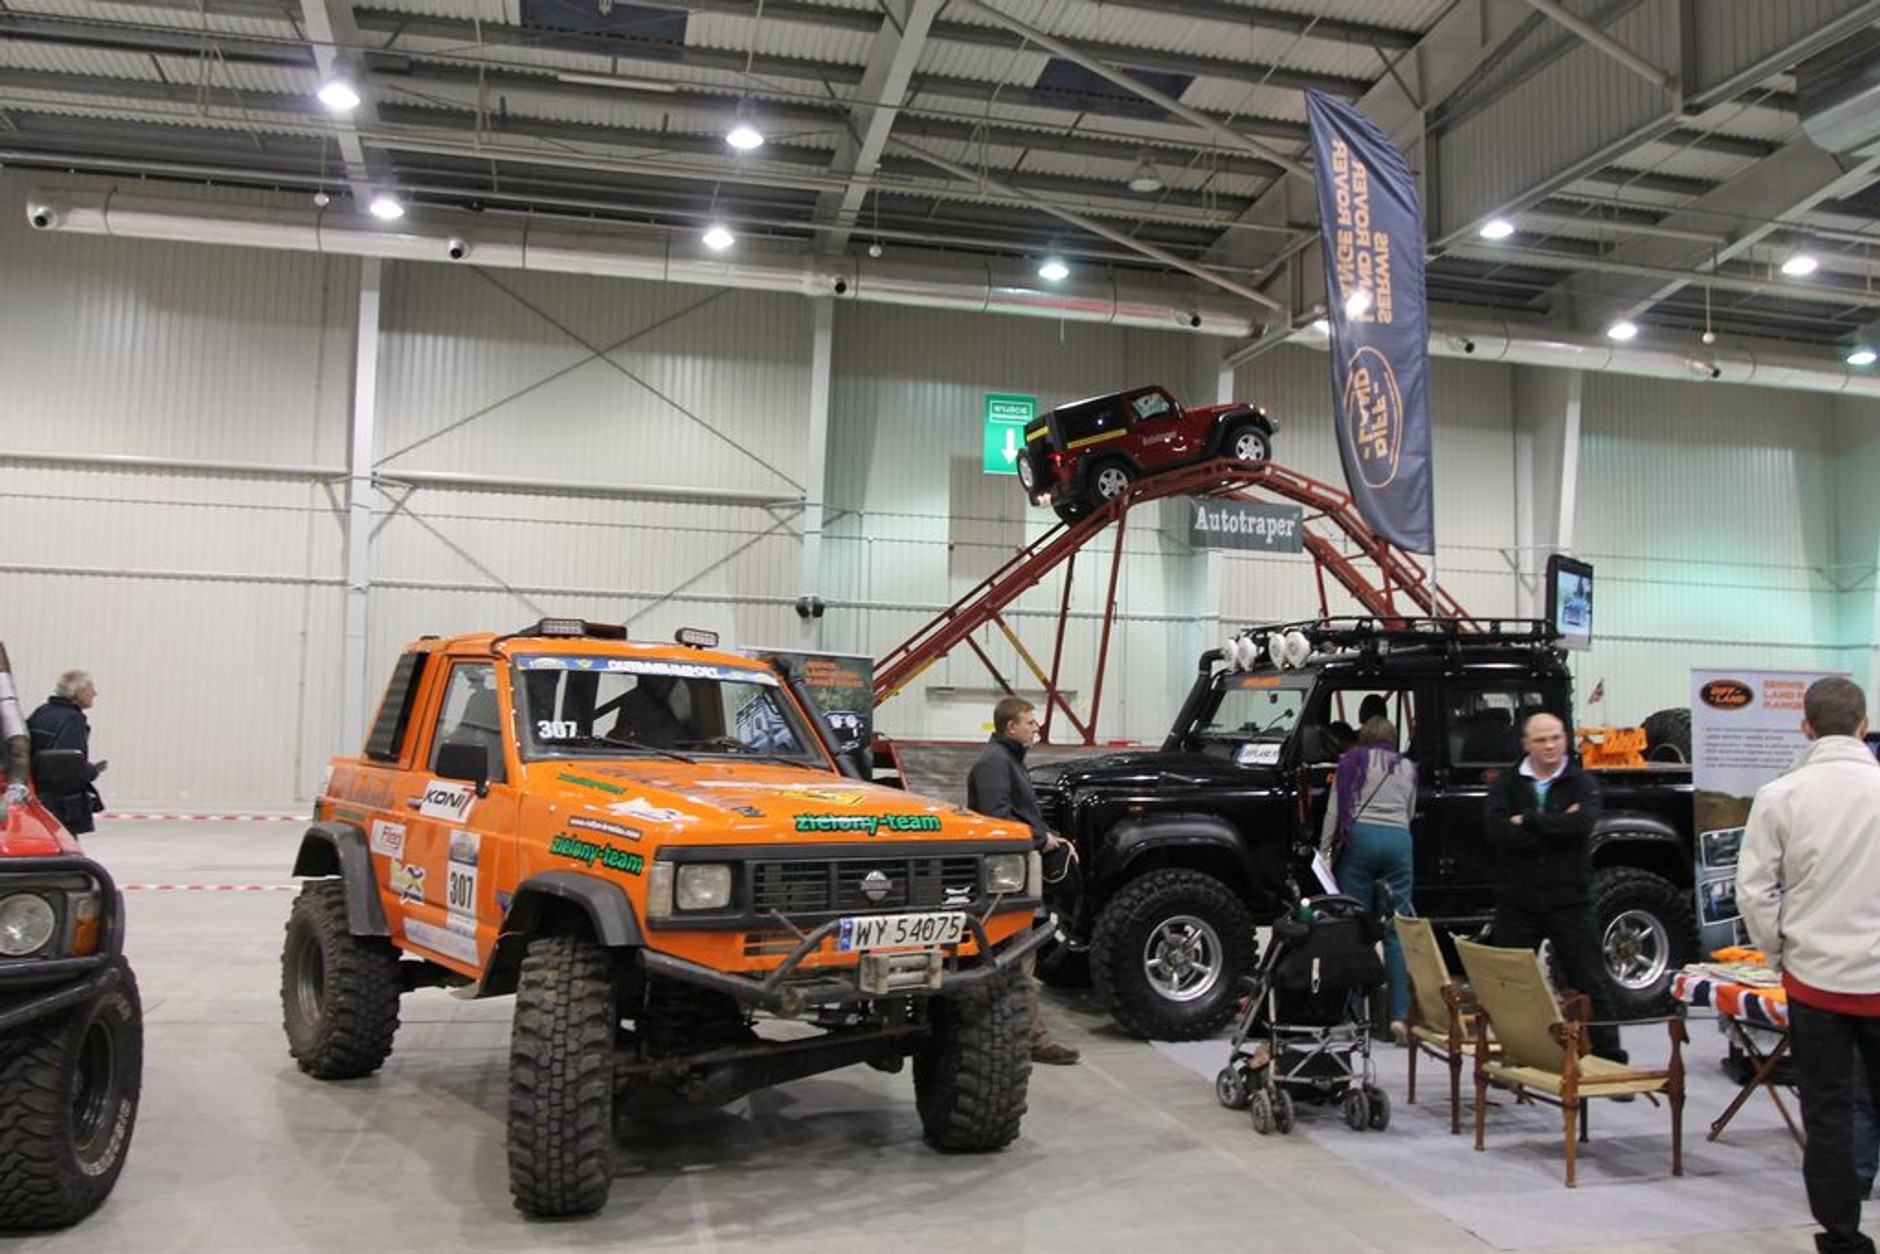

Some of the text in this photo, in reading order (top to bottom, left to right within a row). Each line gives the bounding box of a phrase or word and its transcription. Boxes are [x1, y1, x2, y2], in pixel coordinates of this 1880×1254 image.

[1194, 506, 1296, 544] Autotraper
[537, 721, 577, 739] 307
[423, 788, 466, 808] KONI
[449, 871, 474, 909] 307
[855, 916, 961, 945] WY 54075
